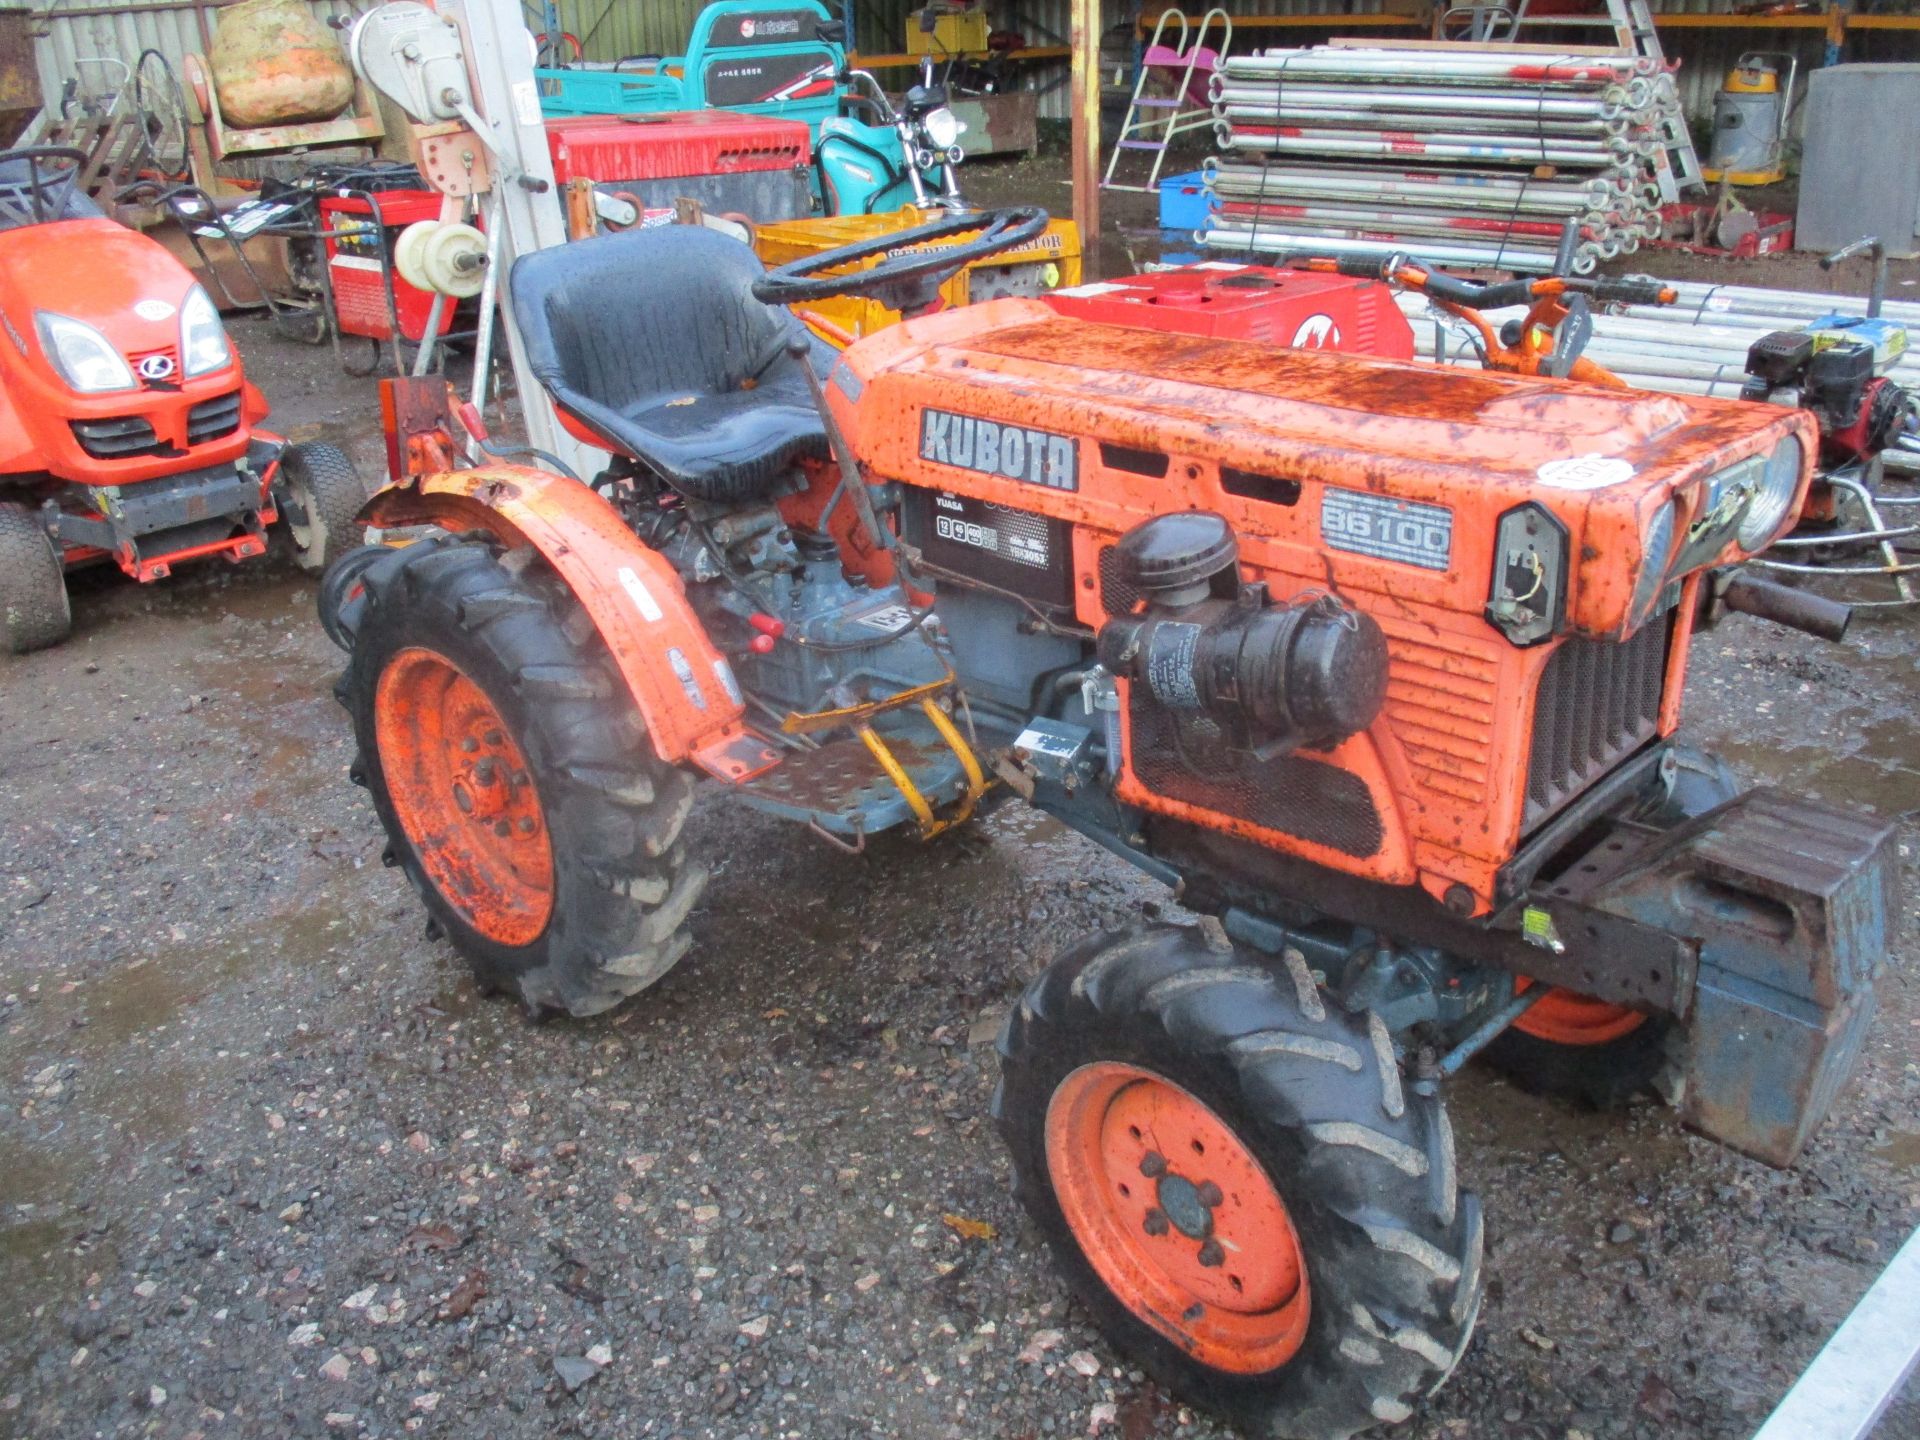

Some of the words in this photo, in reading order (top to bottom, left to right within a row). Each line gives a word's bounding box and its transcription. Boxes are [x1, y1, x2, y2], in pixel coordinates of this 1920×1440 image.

[924, 410, 1074, 490] KUBOTA
[935, 496, 964, 512] YUASA
[940, 520, 949, 531] 12
[1322, 505, 1450, 552] B6100
